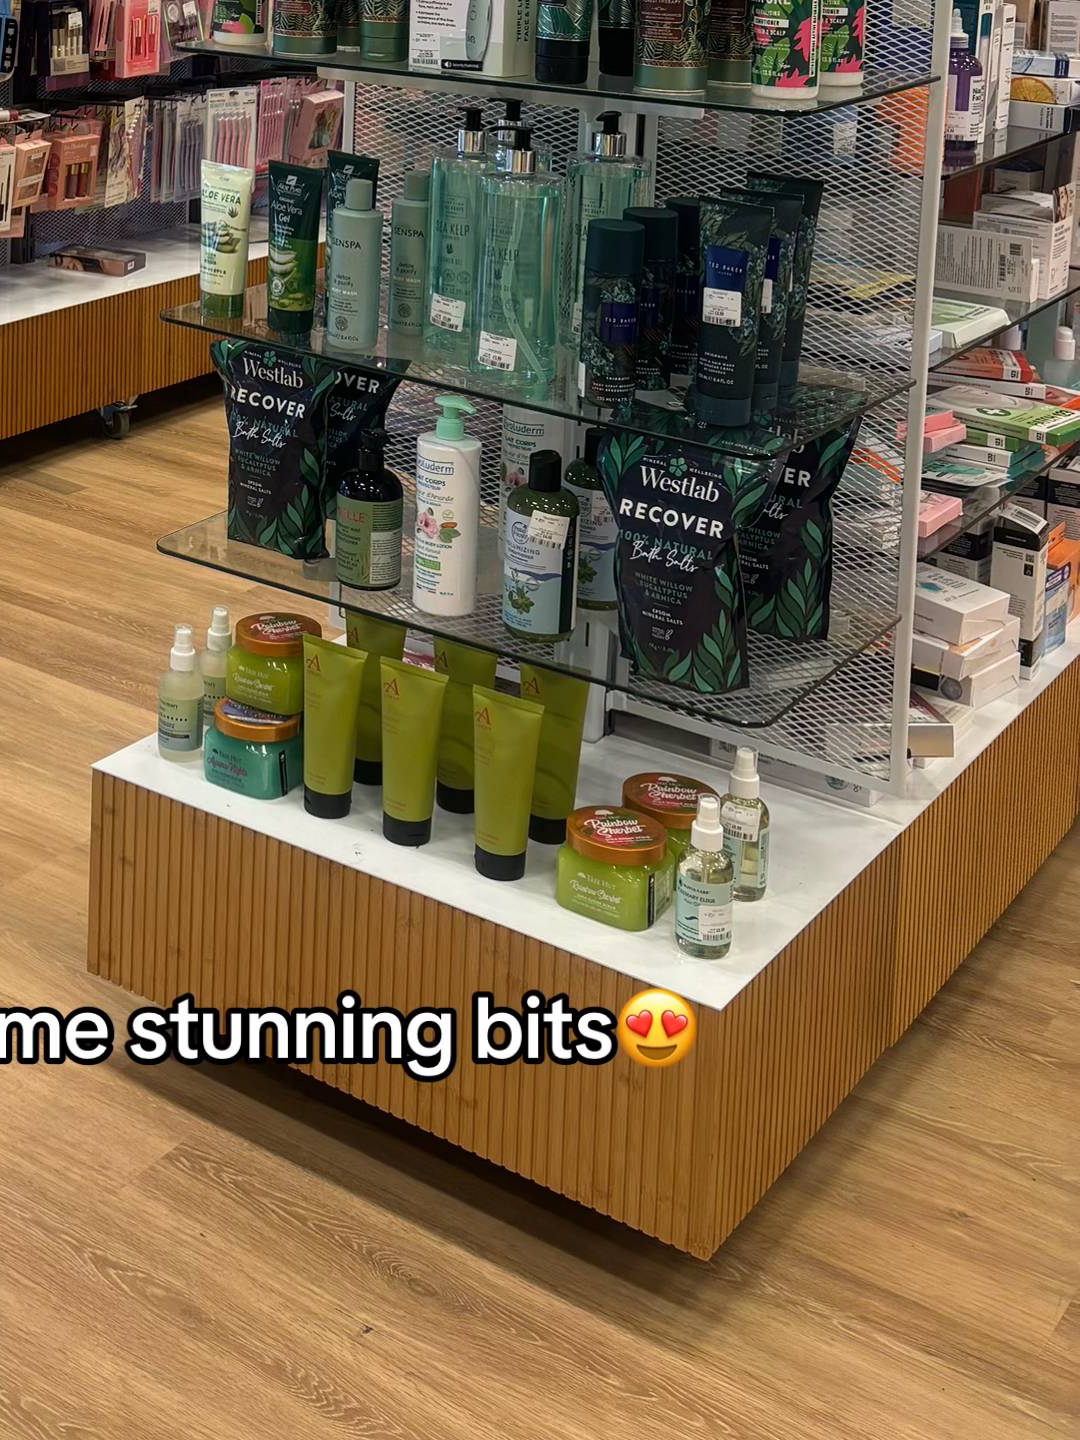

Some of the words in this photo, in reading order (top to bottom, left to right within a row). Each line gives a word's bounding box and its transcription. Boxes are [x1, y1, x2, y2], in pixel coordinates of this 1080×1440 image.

[220, 191, 241, 205] VERA
[278, 212, 291, 223] Gel
[287, 205, 303, 216] Vera
[449, 219, 470, 237] KELP
[242, 356, 304, 389] Westlab
[230, 386, 306, 419] RECOVER
[232, 421, 259, 439] Bath
[260, 429, 287, 449] Salts
[640, 464, 720, 503] Westlab
[619, 497, 725, 539] RECOVER
[629, 540, 663, 564] Bath
[665, 549, 699, 573] Salts
[654, 536, 713, 561] NATURAL
[634, 571, 658, 585] WHITE
[659, 577, 694, 593] WILLOW
[639, 580, 688, 599] EUCALYPTUS
[651, 591, 682, 606] ARNICA
[642, 610, 665, 621] MINERAL
[666, 616, 684, 626] SALTS
[640, 782, 697, 794] Rainbow
[584, 818, 638, 831] Rainbow
[597, 824, 647, 839] Sherbet
